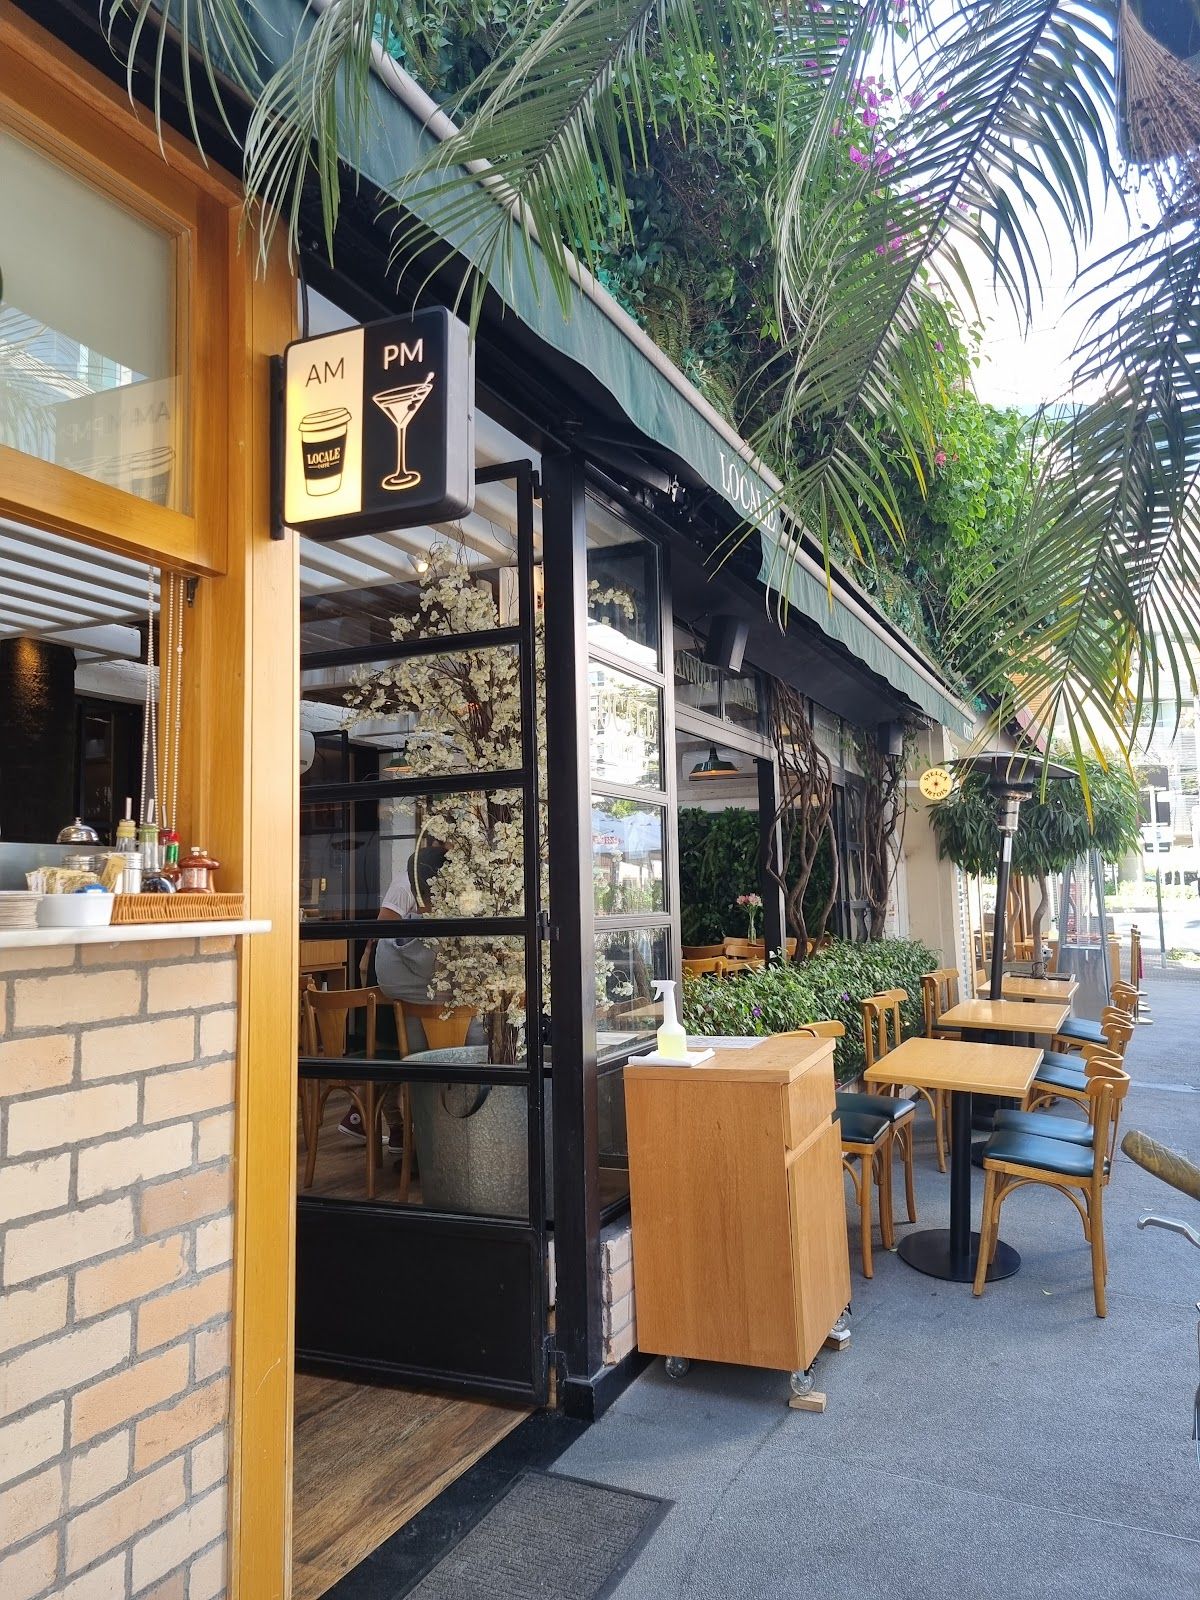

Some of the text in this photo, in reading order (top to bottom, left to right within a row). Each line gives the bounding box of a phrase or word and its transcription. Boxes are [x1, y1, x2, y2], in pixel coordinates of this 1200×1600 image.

[384, 338, 423, 370] PM
[305, 357, 344, 387] AM
[306, 447, 341, 465] LOCALE
[923, 770, 948, 782] STELLA
[924, 787, 948, 798] ARTOIS
